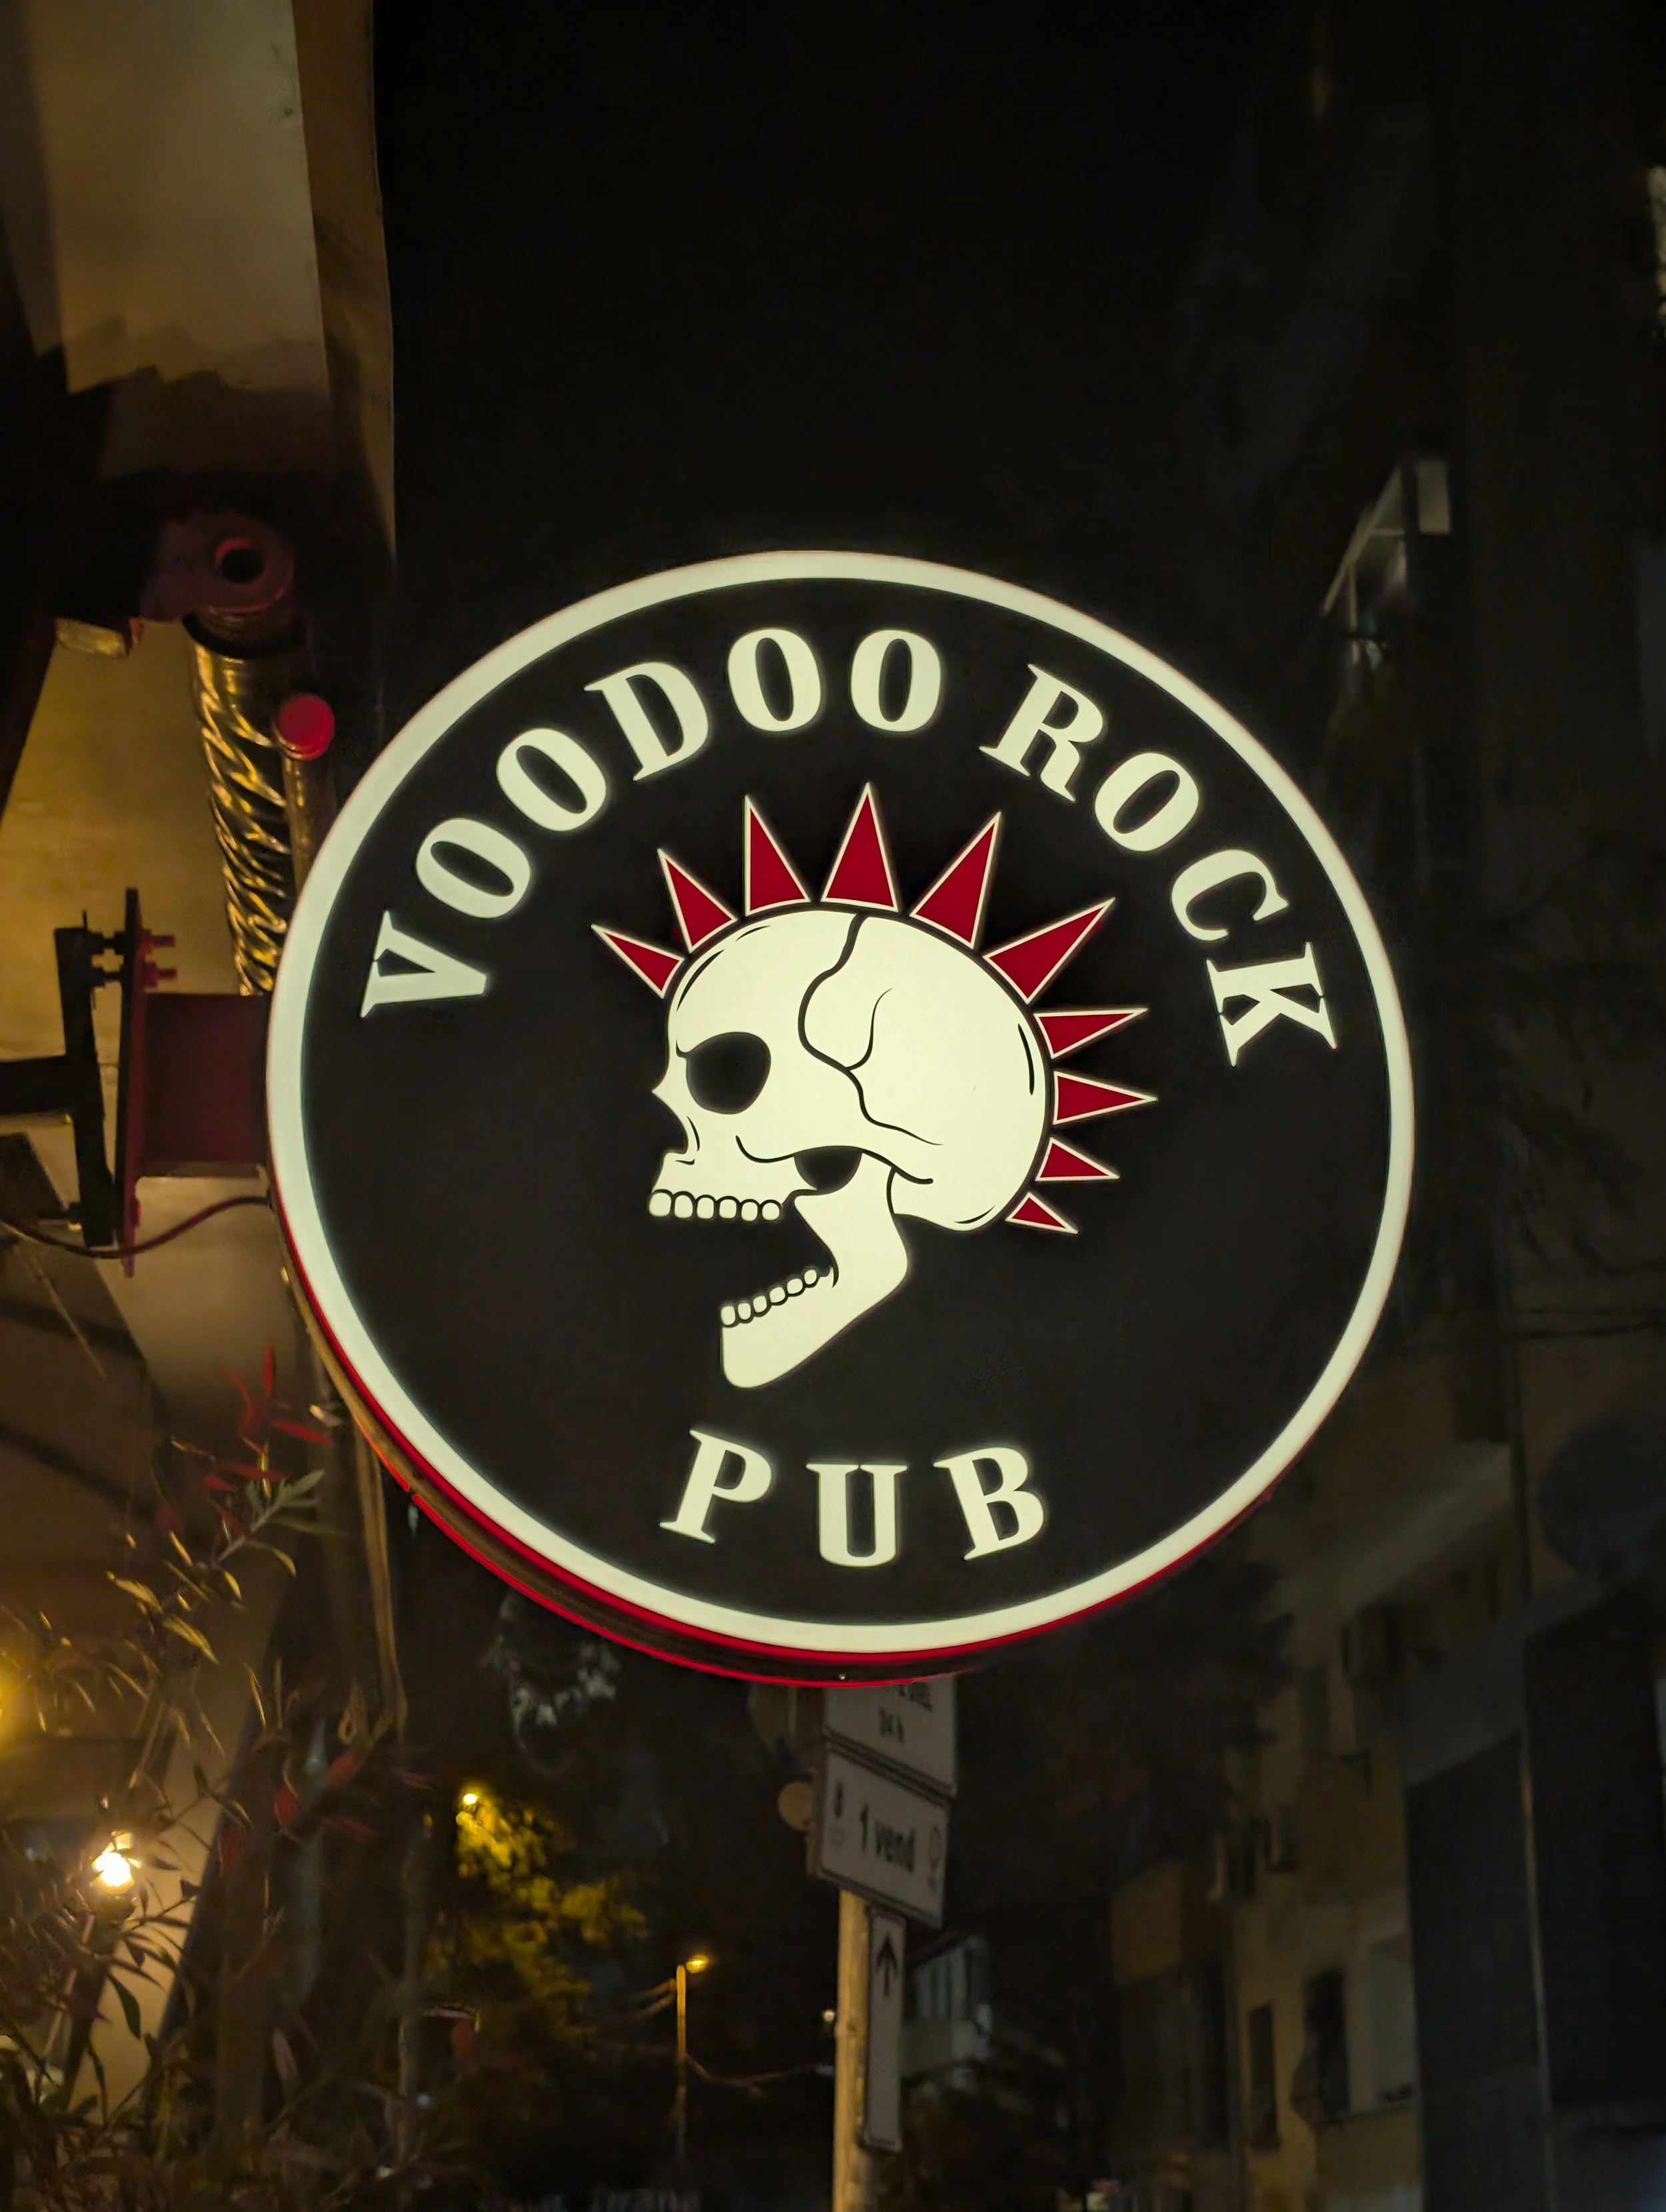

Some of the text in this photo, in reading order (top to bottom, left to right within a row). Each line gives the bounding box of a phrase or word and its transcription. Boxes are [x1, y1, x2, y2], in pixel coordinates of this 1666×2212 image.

[361, 628, 1337, 1067] VOODOO ROCK
[659, 1430, 1044, 1567] PUB
